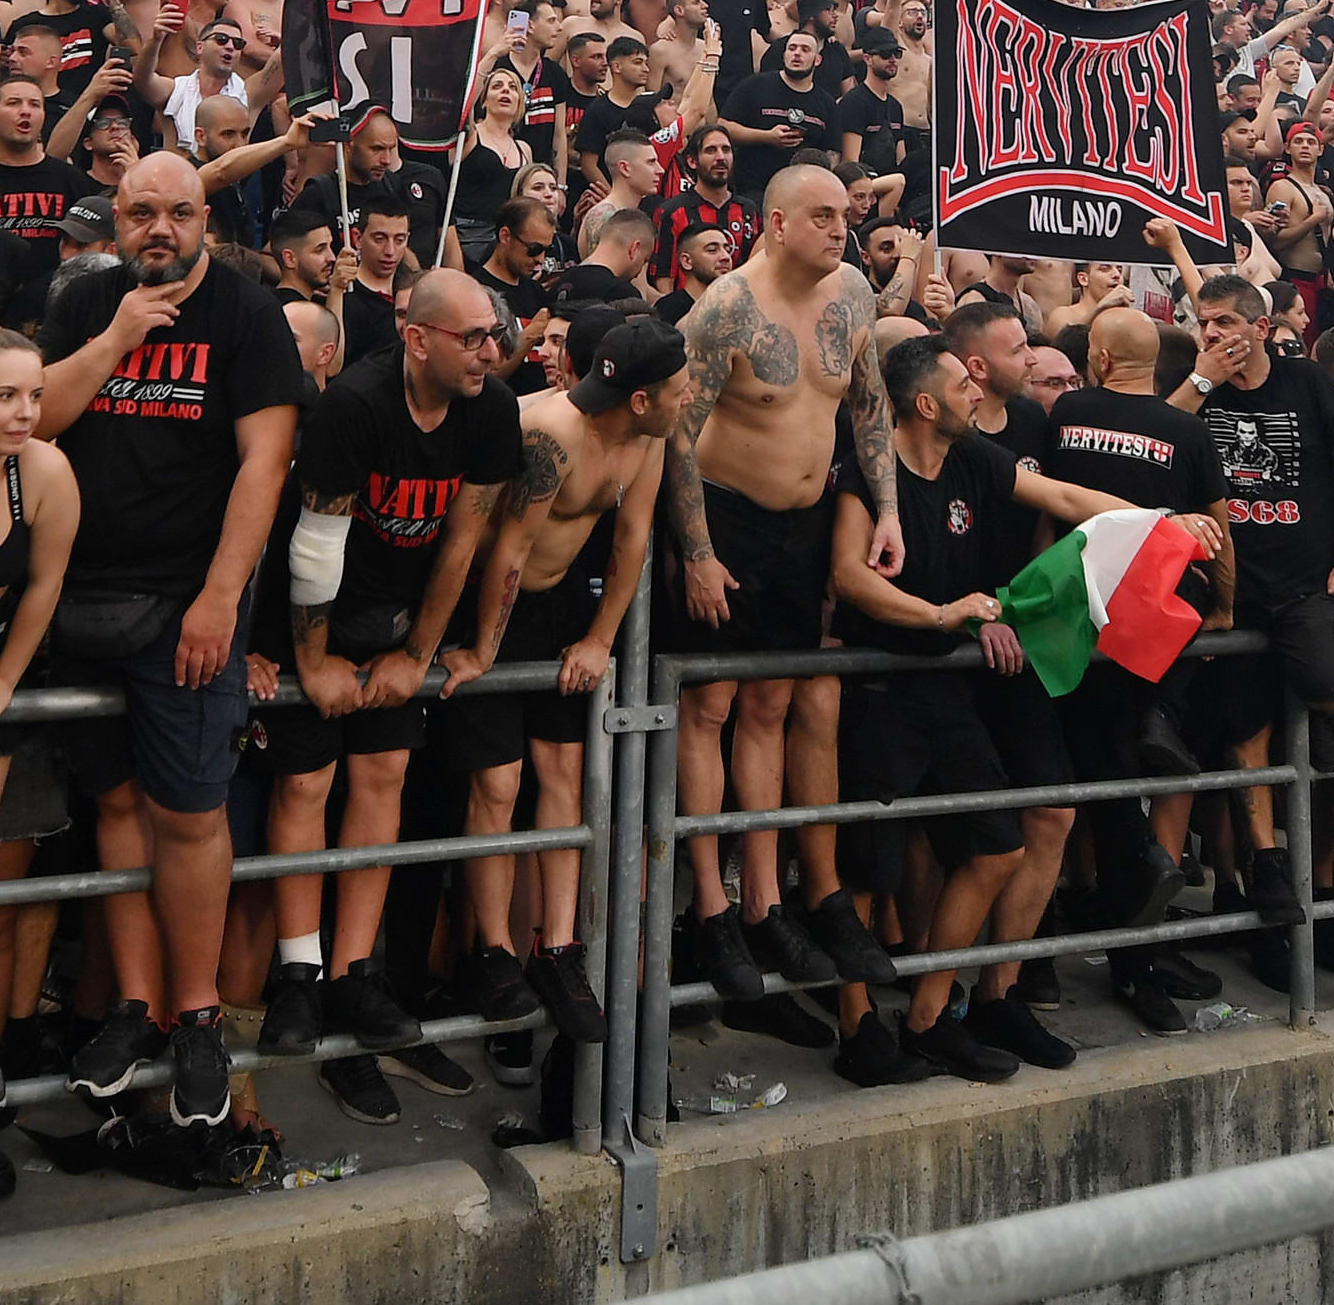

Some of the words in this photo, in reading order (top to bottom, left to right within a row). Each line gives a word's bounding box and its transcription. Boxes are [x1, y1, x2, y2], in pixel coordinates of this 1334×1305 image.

[1027, 194, 1123, 239] MILANO
[141, 401, 203, 421] MILANO
[1060, 427, 1152, 460] NERVITESI
